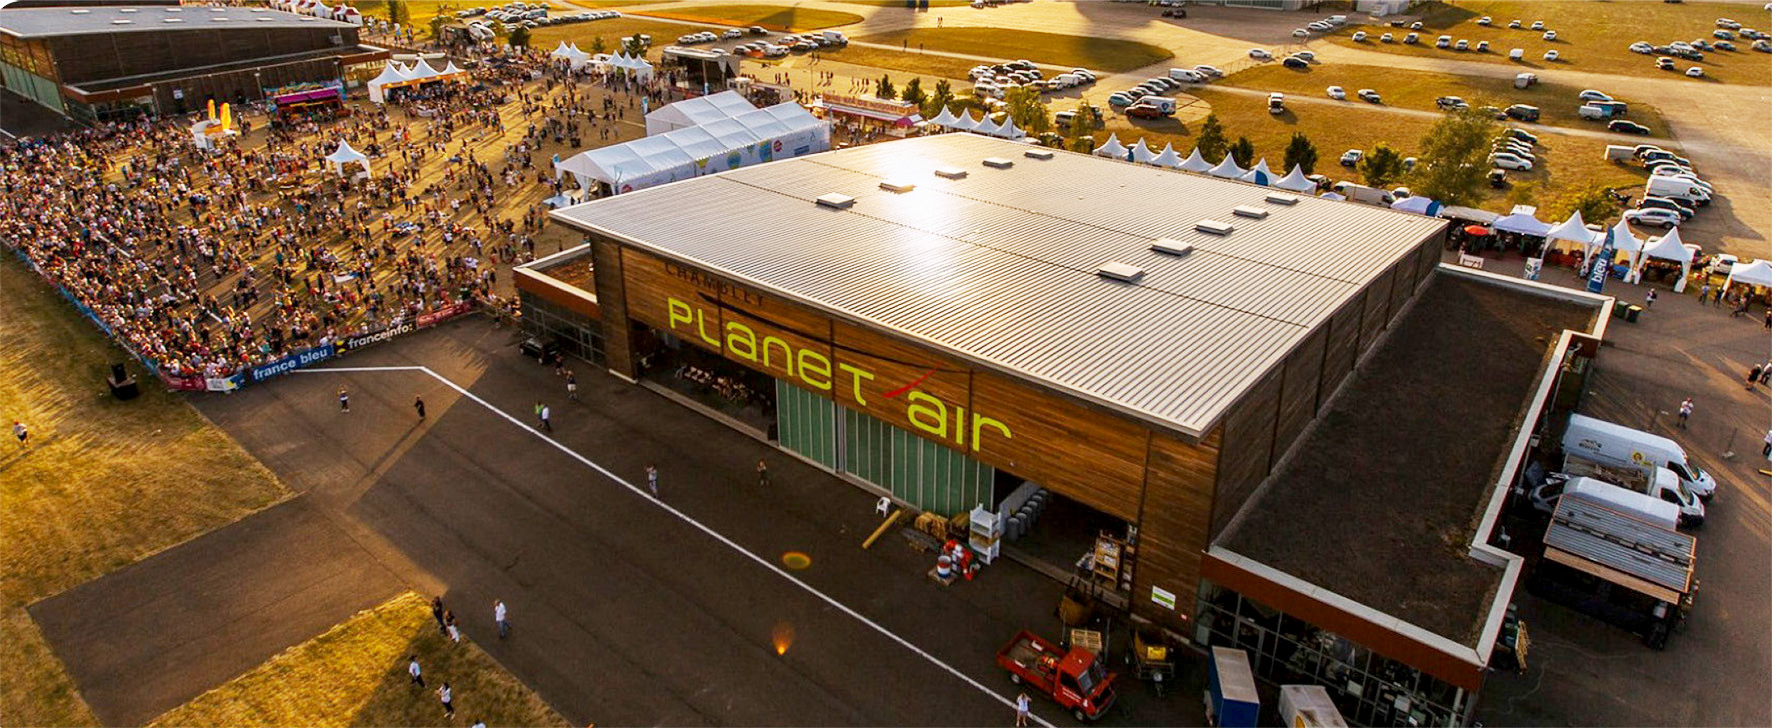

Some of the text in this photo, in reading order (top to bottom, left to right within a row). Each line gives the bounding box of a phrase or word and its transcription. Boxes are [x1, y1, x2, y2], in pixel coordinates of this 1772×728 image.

[1591, 258, 1607, 283] bleu
[348, 323, 413, 350] franceinfo:
[253, 348, 328, 381] france bleu
